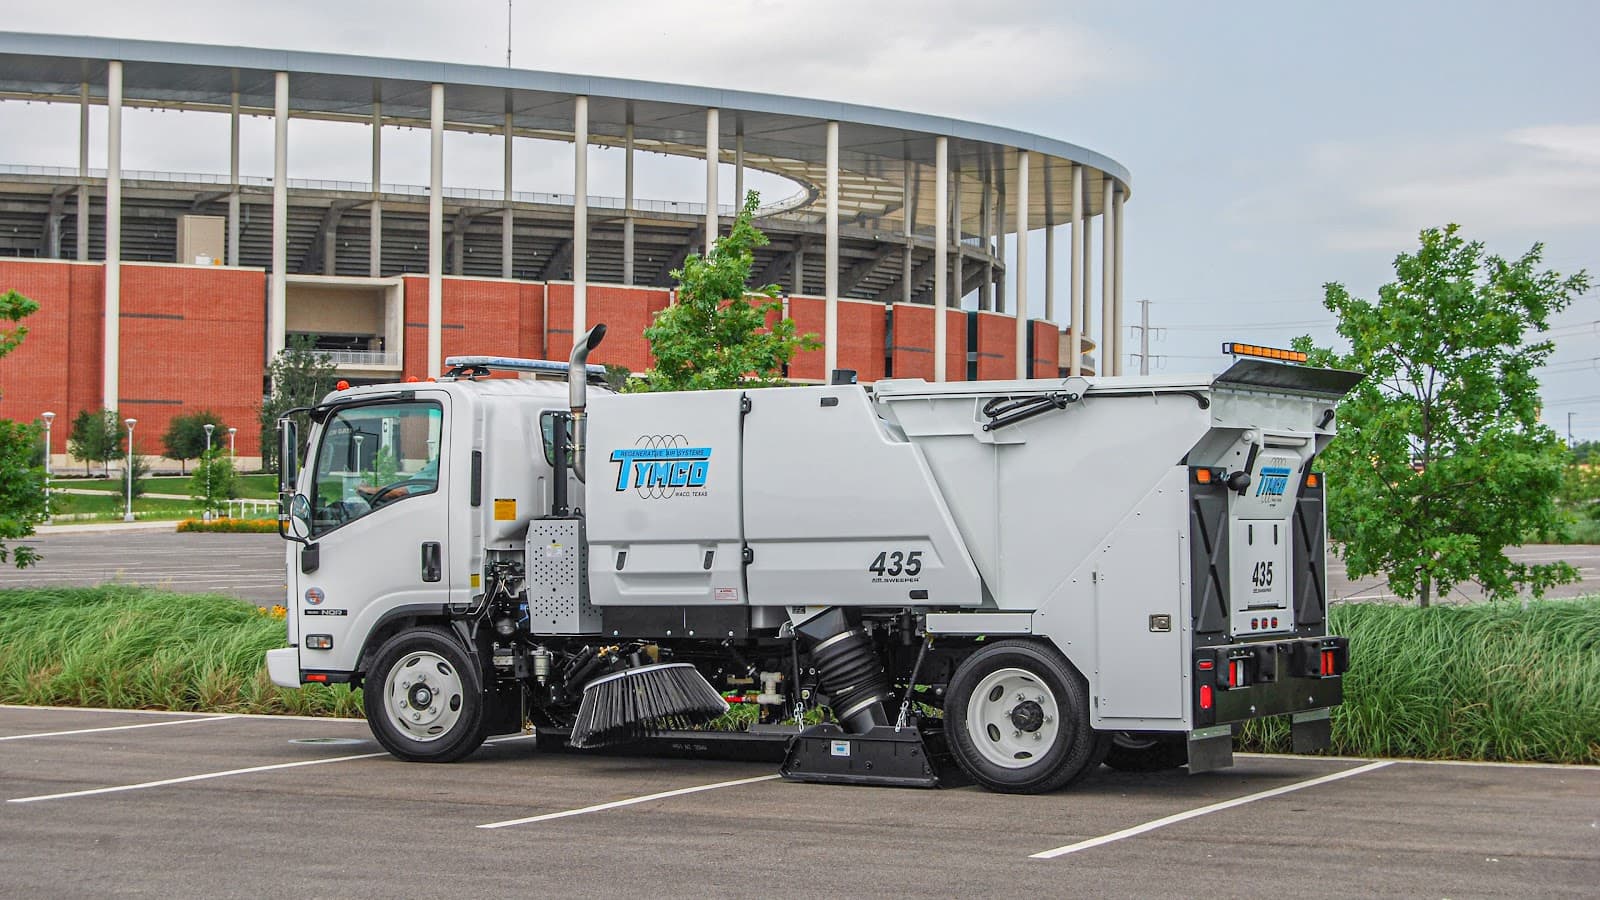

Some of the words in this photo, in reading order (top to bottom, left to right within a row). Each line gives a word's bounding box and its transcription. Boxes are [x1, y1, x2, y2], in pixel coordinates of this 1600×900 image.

[609, 447, 712, 491] TYMCO
[869, 551, 923, 577] 435
[1252, 561, 1273, 587] 435
